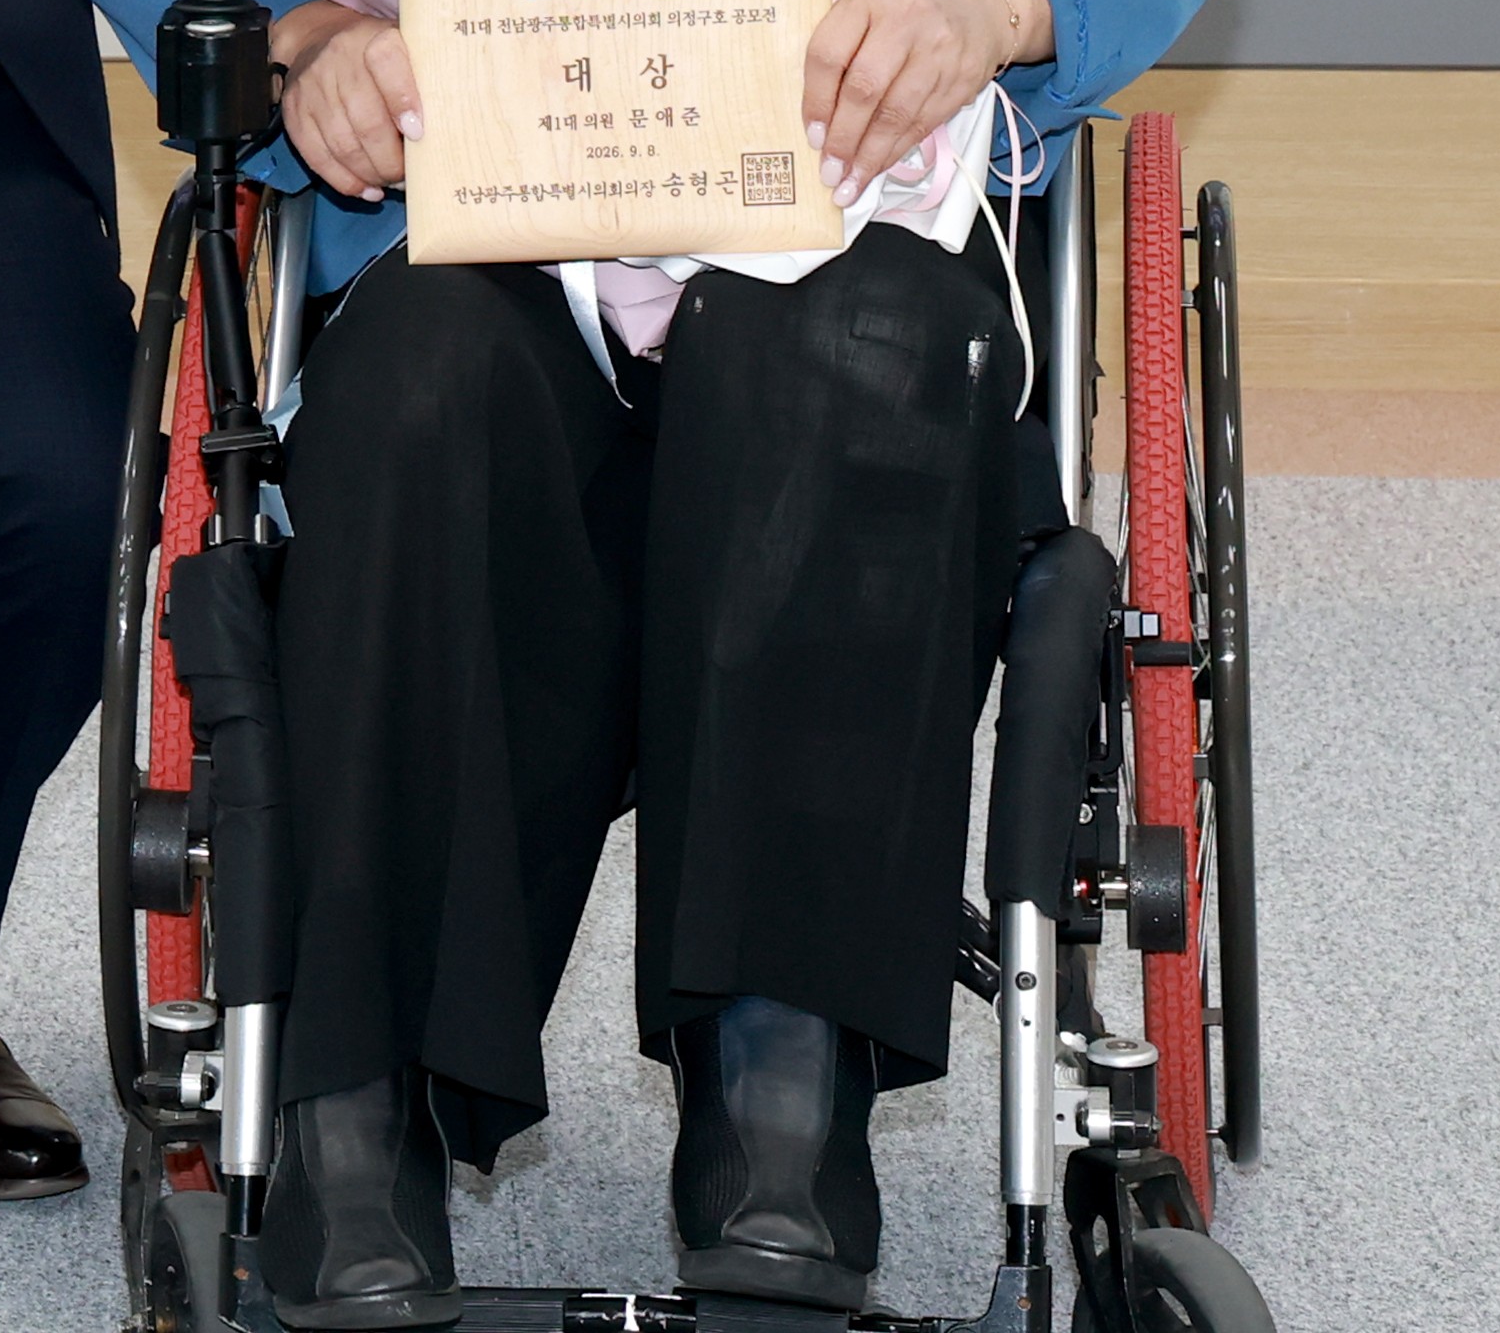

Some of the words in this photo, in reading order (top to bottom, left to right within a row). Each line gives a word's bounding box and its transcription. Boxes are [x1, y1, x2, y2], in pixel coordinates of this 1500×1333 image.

[454, 18, 492, 36] 제1대
[497, 11, 662, 35] 전남광주통합특별시의회
[667, 8, 728, 27] 의정구호
[731, 6, 777, 25] 공모전
[538, 114, 578, 131] 제1대
[583, 112, 614, 130] 의원
[586, 146, 624, 159] 2026.
[629, 145, 642, 158] 9.
[647, 144, 660, 157] 8.
[453, 179, 656, 206] 전남광주통합특별시의회의장
